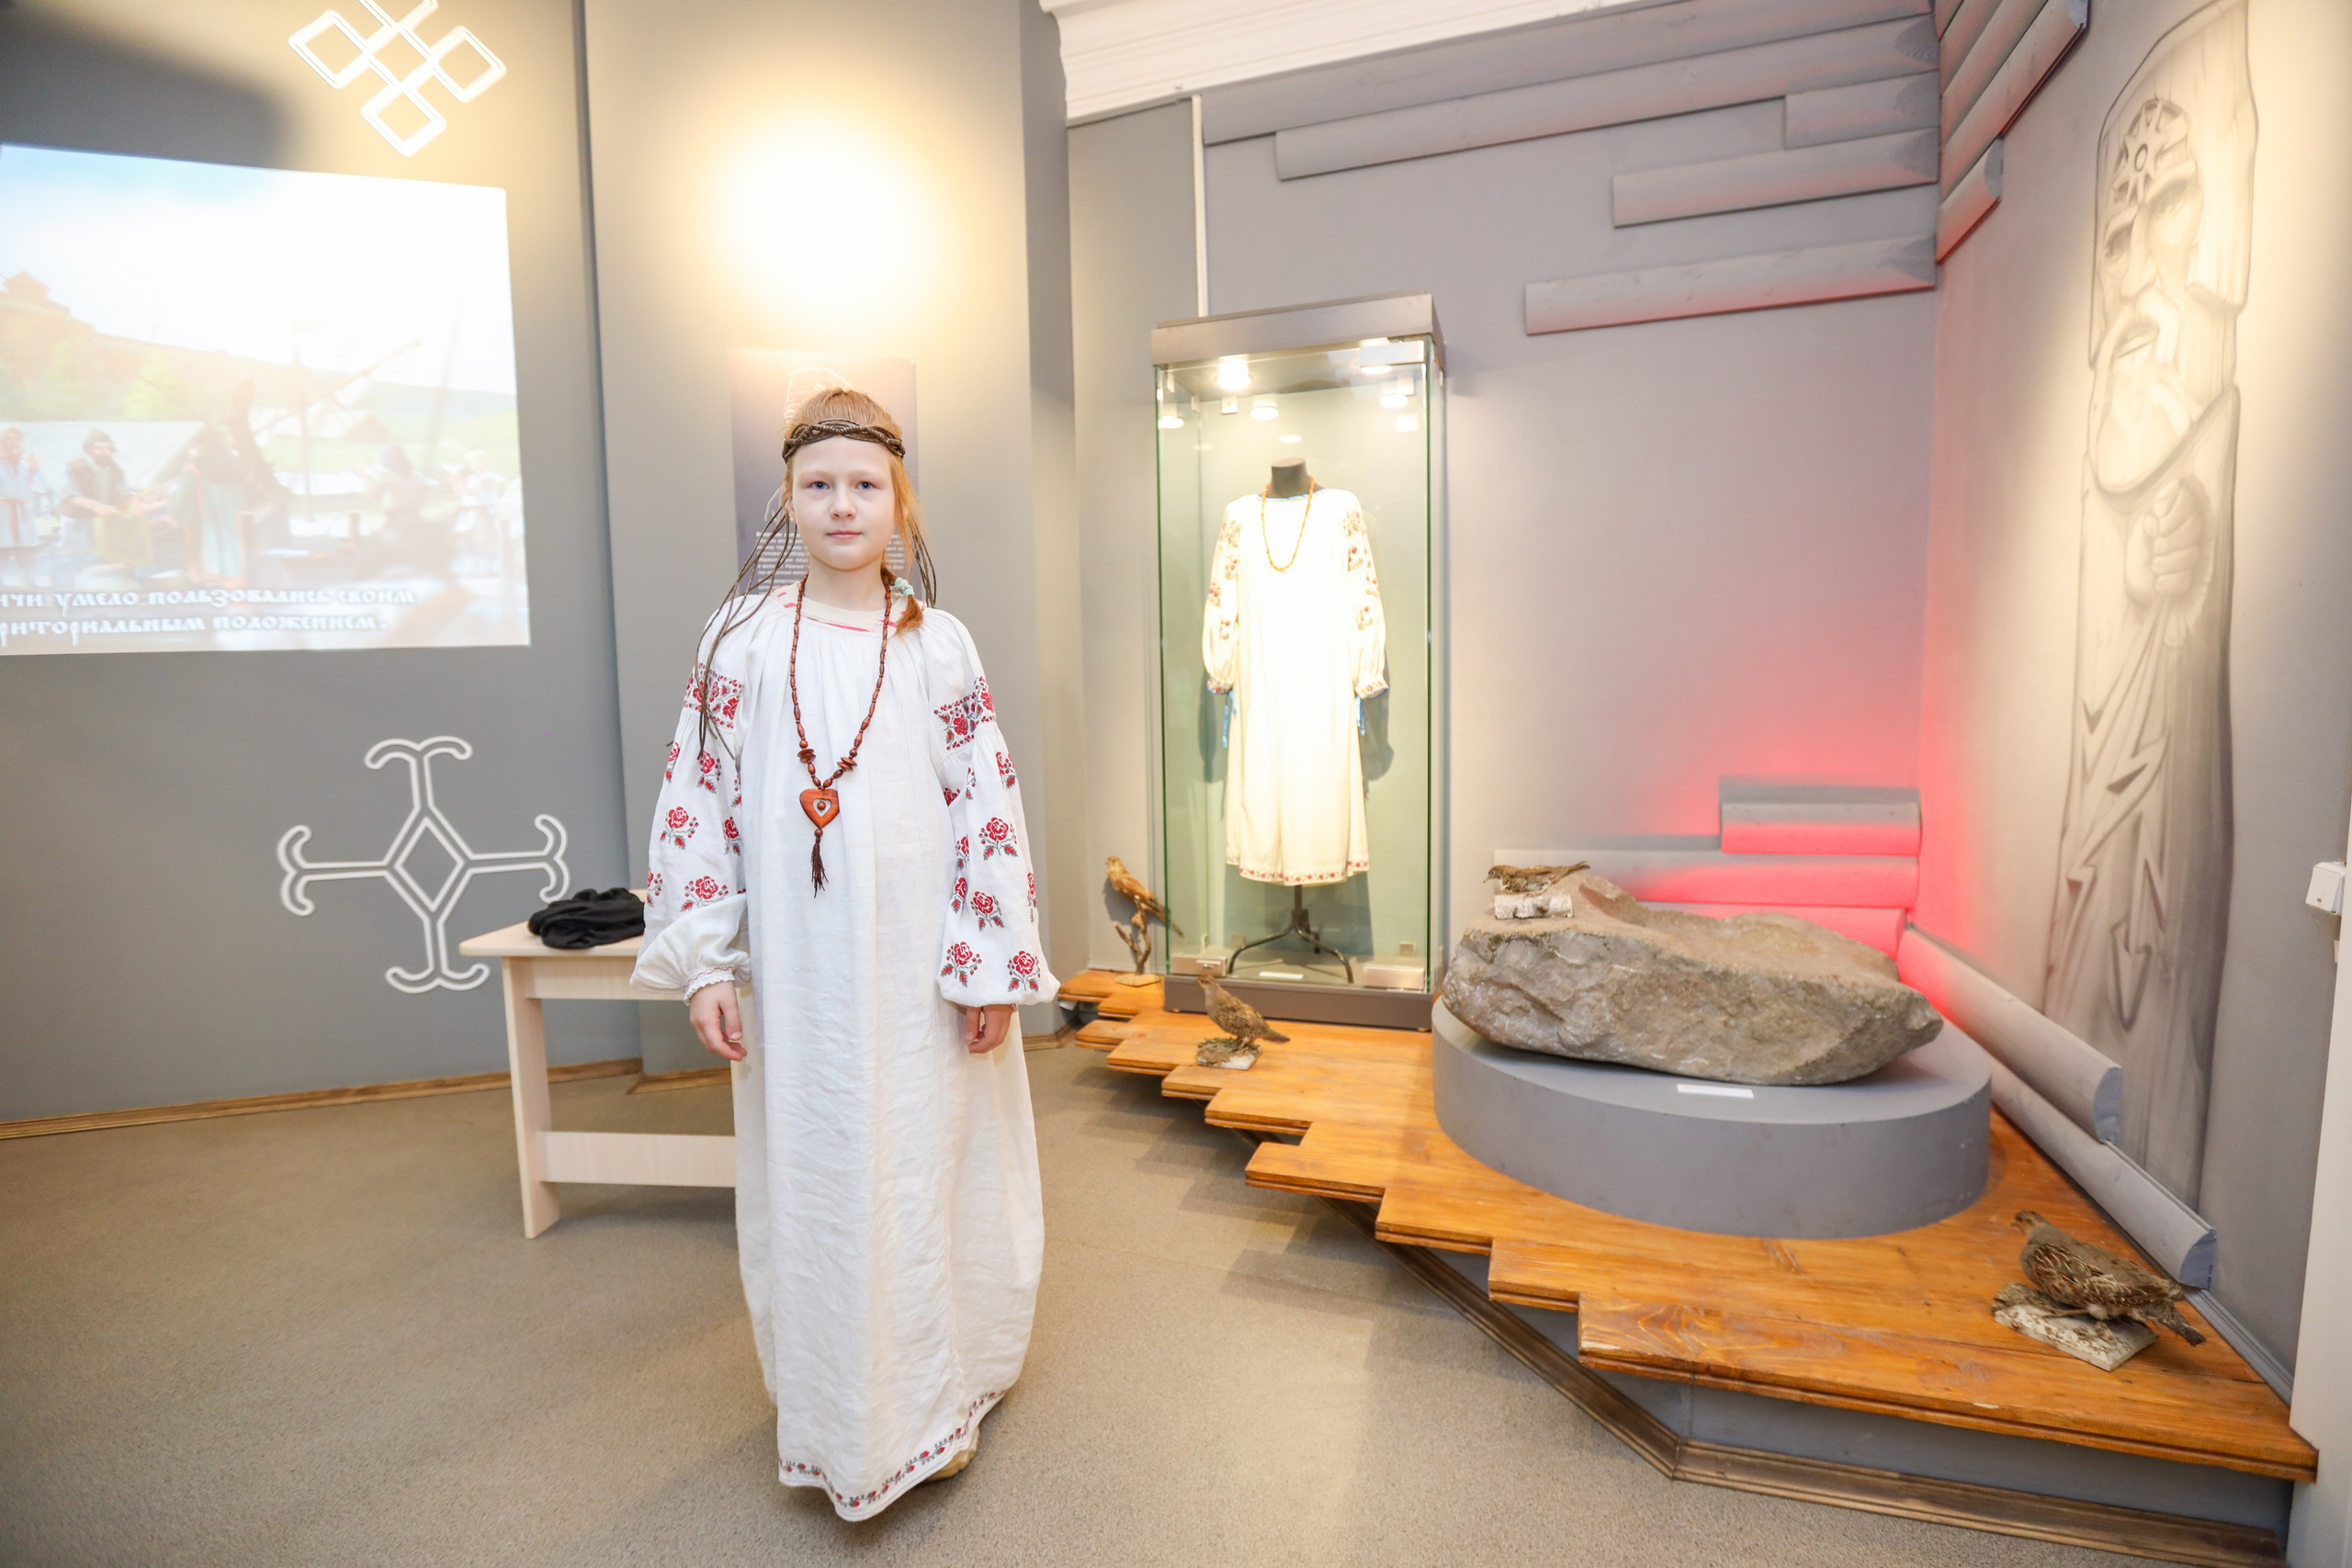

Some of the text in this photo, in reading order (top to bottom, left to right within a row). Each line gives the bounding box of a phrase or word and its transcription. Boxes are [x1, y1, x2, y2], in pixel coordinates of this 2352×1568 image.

[53, 592, 140, 617] умело
[148, 589, 331, 608] пользовались
[338, 589, 415, 604] своим
